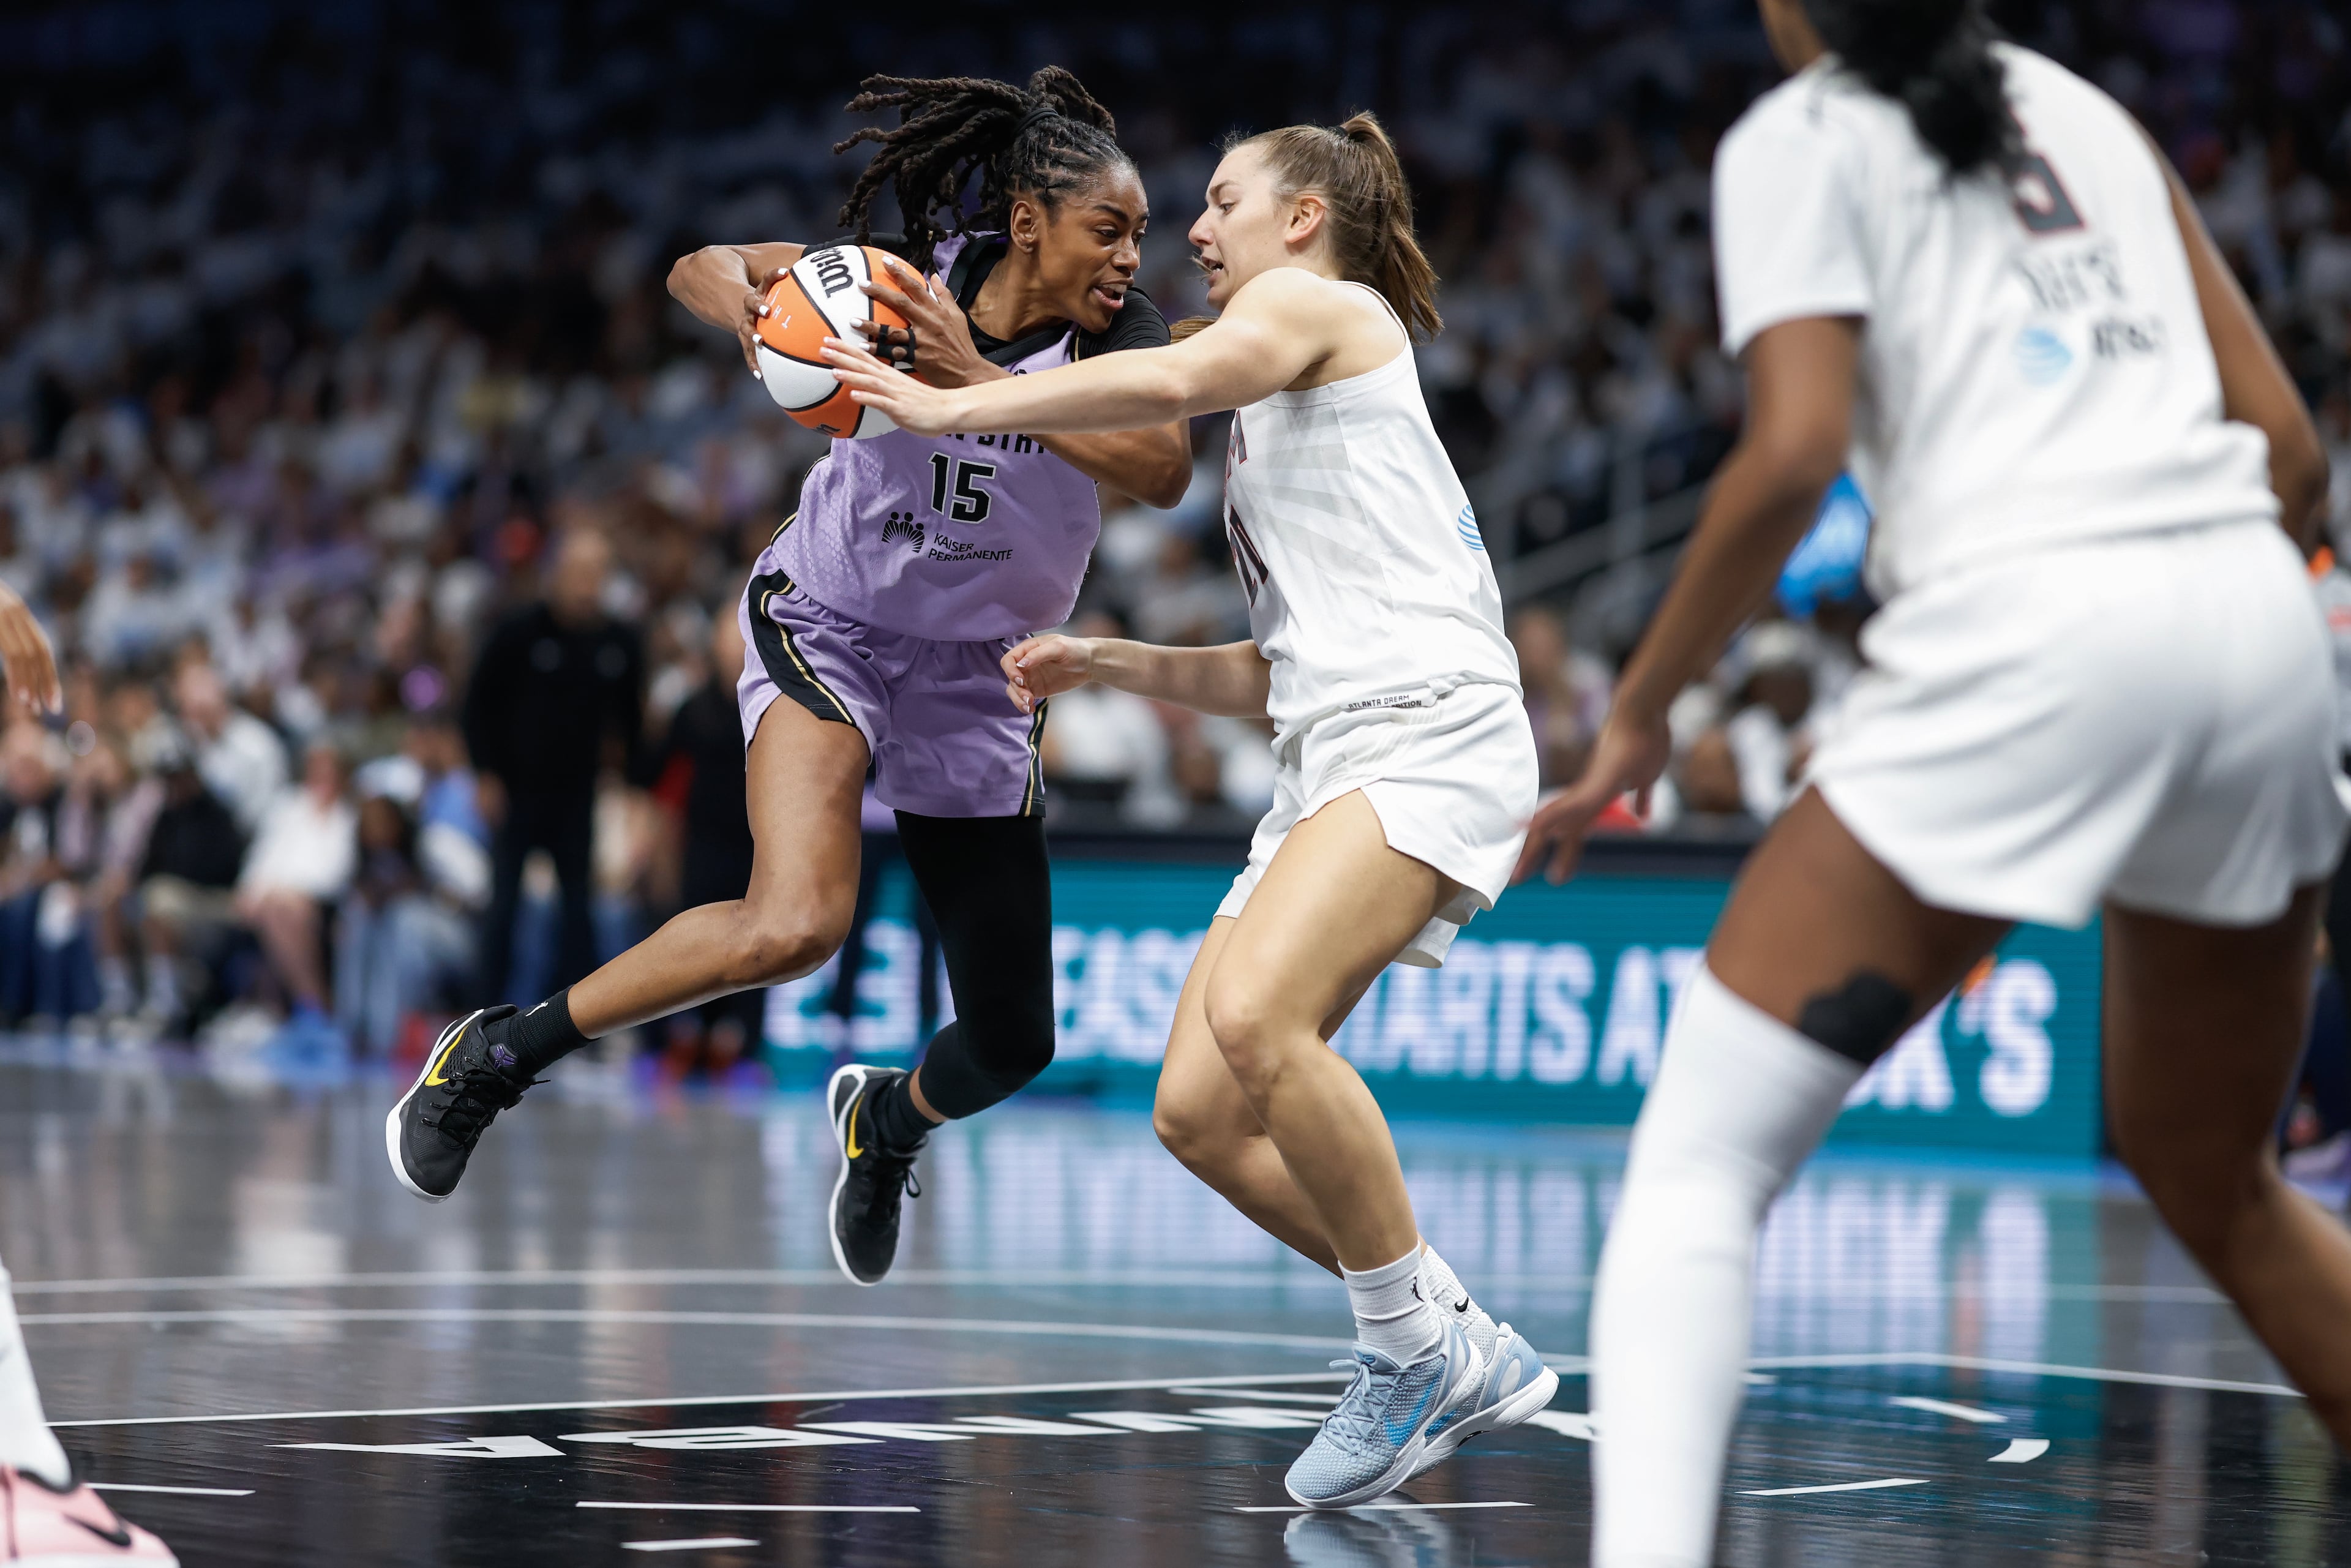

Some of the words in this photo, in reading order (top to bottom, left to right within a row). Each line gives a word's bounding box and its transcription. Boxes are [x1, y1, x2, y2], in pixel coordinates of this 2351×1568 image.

[928, 451, 997, 524] 15
[934, 533, 974, 552] KAISER
[928, 548, 1013, 561] PERMANENTE
[1348, 698, 1381, 709] ATLANTA
[1384, 694, 1410, 705] DREAM
